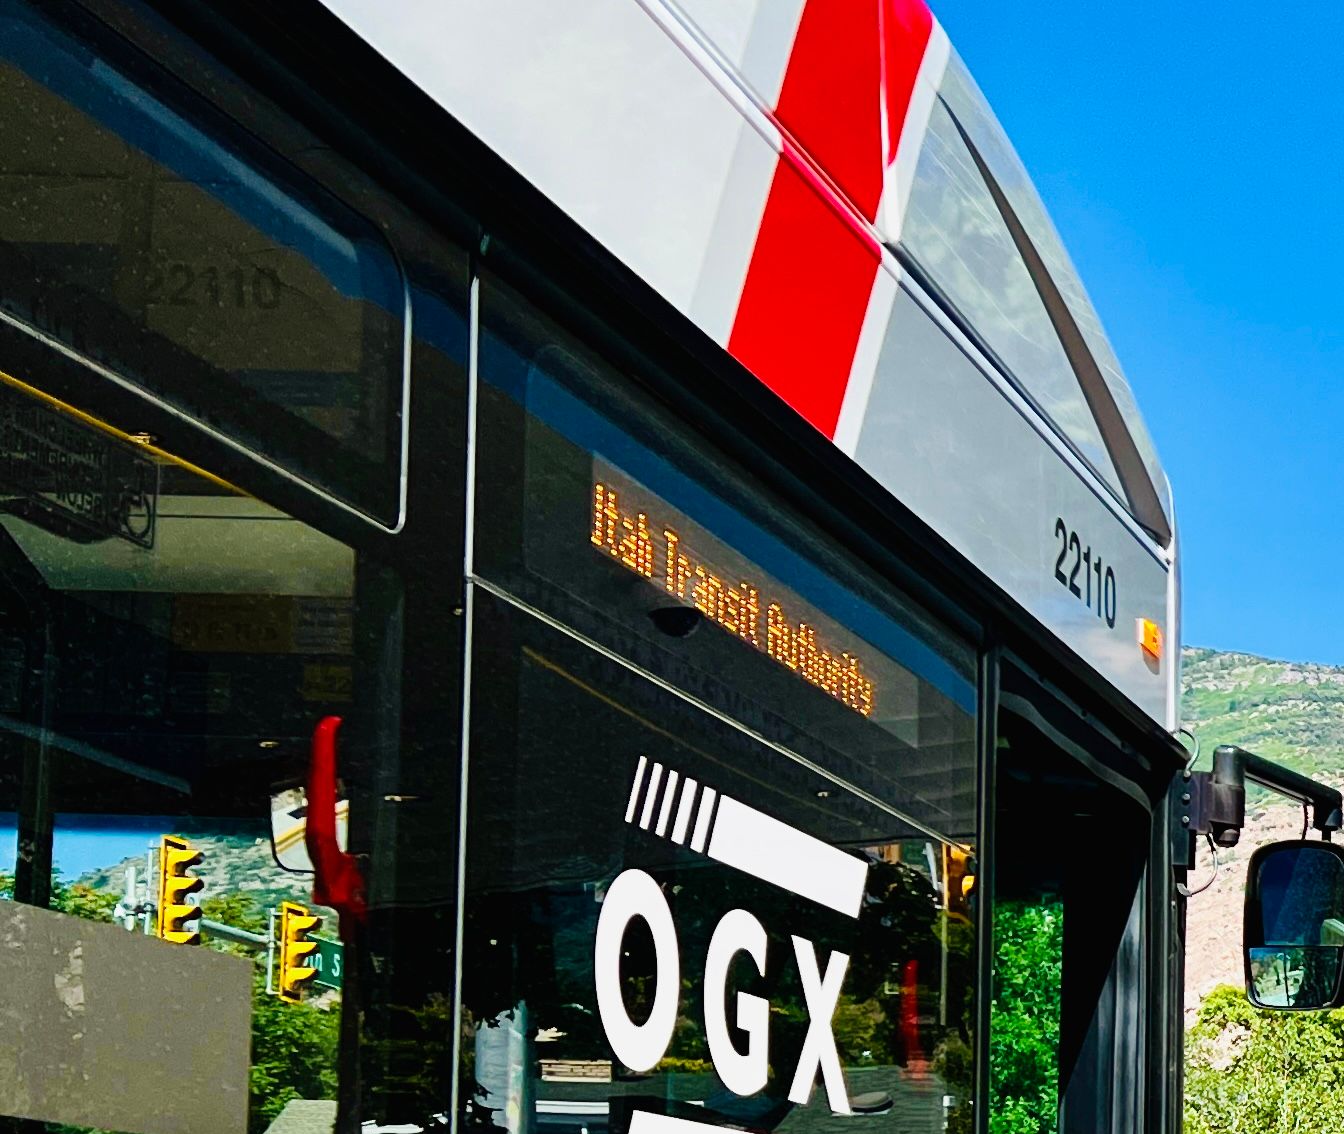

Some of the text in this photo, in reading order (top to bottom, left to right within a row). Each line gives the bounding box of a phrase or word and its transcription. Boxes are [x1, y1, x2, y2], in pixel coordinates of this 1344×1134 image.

[591, 484, 873, 717] Utah Transit Authority
[1054, 517, 1116, 629] 22110
[595, 868, 851, 1116] OGX
